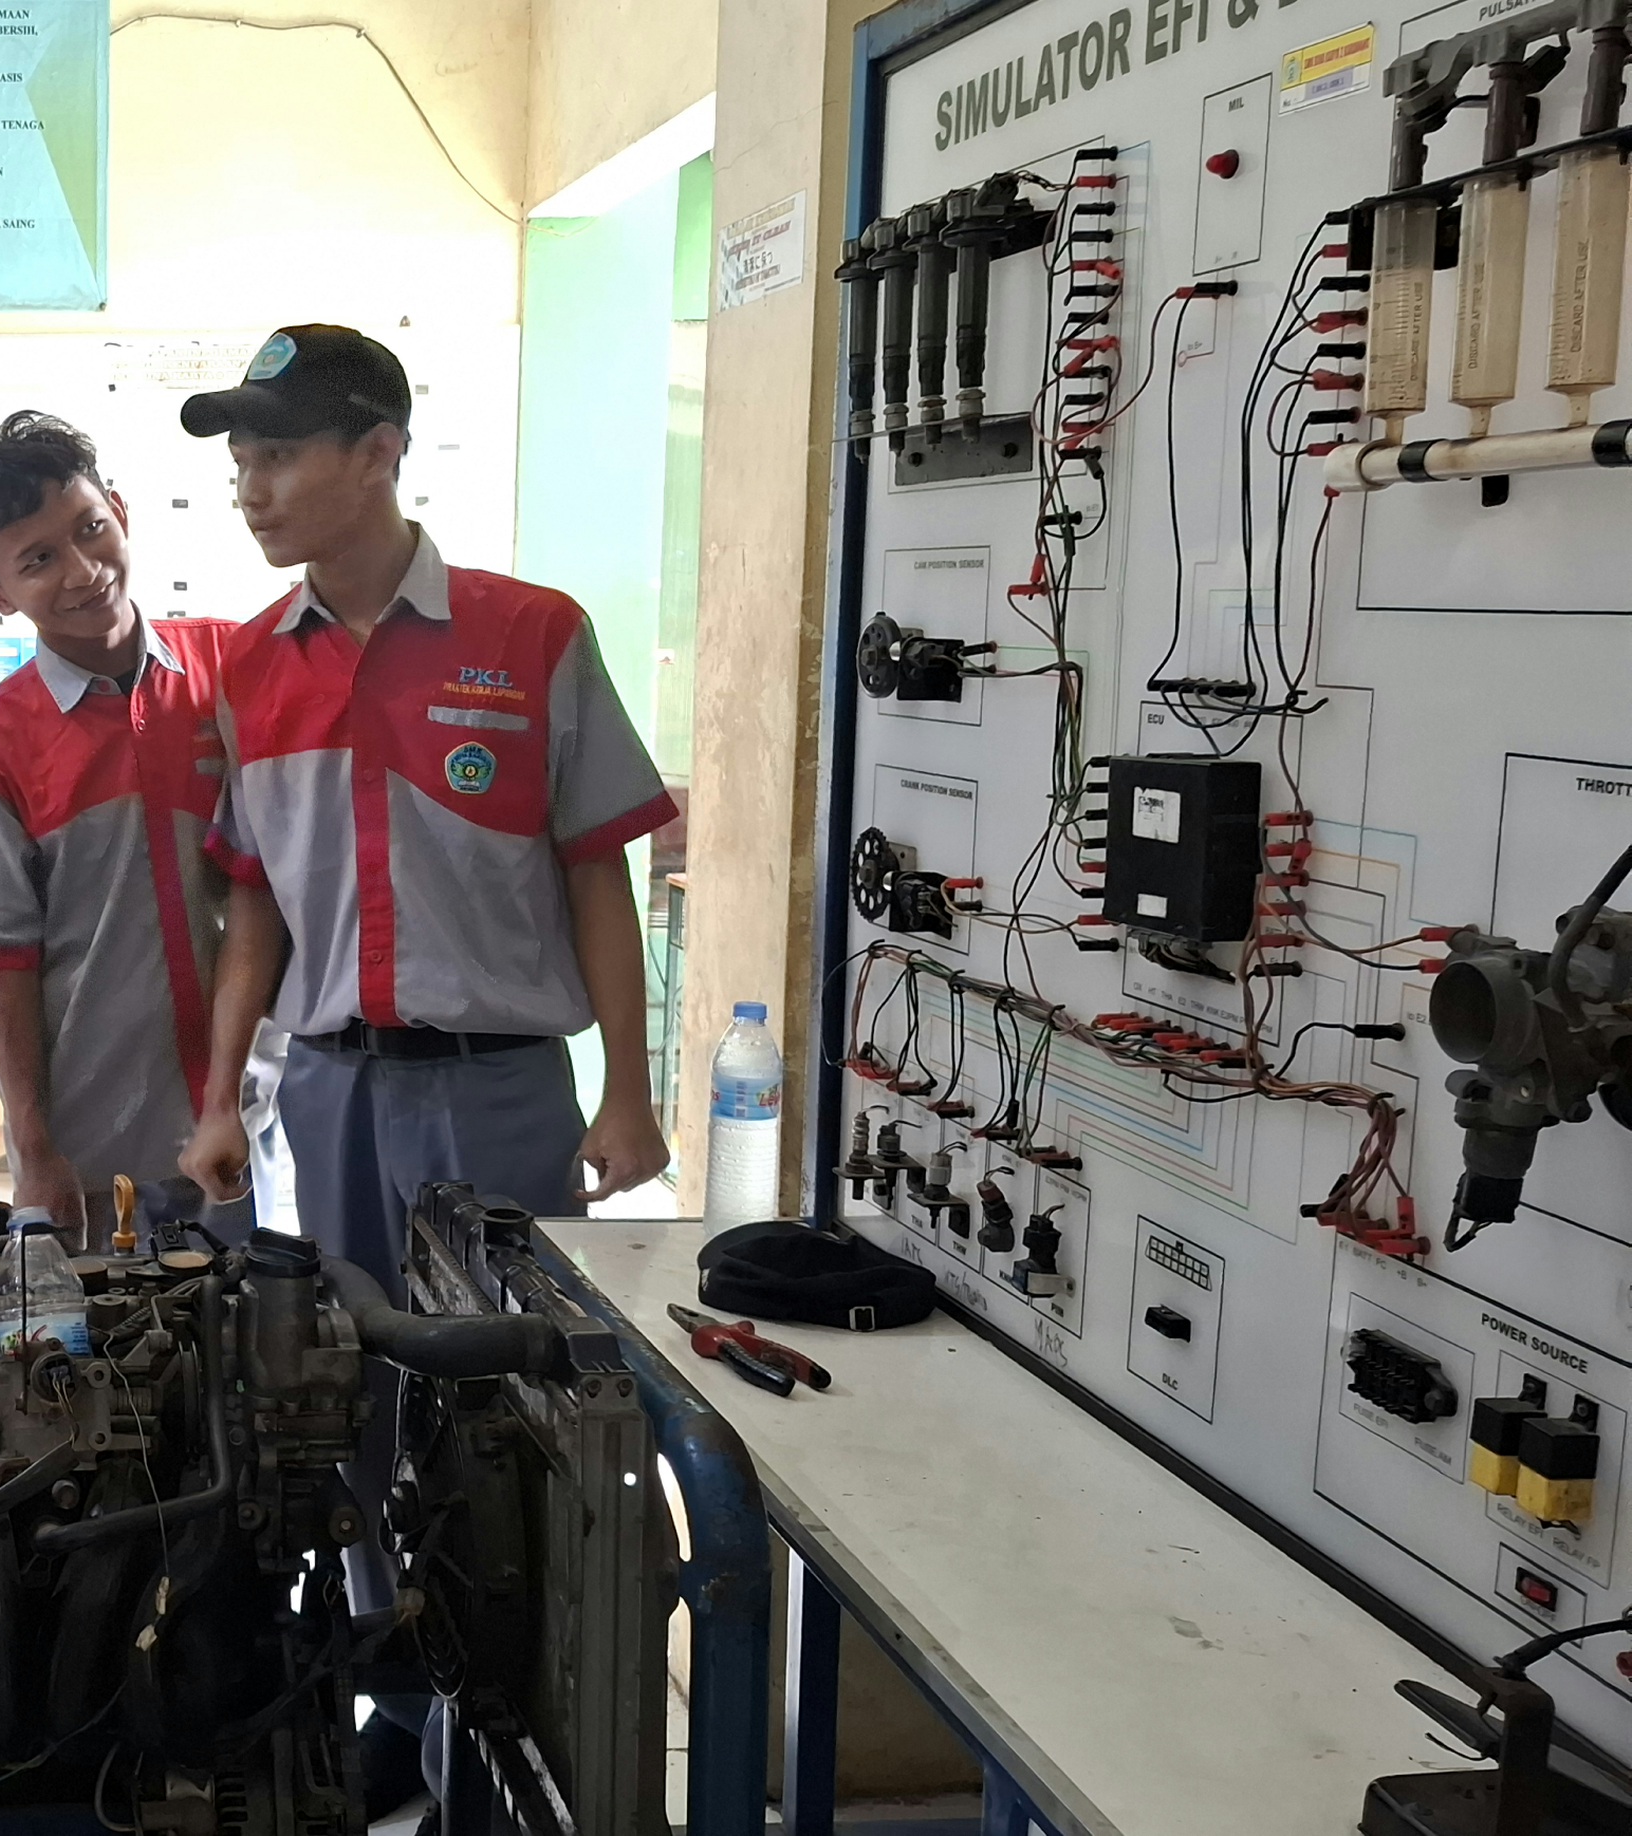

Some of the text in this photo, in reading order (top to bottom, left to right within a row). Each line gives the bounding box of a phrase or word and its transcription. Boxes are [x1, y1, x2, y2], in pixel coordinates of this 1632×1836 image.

[935, 7, 1132, 151] SIMULATOR
[1228, 96, 1245, 112] MIL
[1, 120, 44, 129] TENAGA
[3, 218, 36, 228] SAING
[1575, 265, 1587, 302] AFTER
[928, 560, 957, 569] POSITION
[958, 559, 984, 568] SENSOR
[460, 666, 513, 688] PKL
[1147, 713, 1164, 725] ECU
[900, 779, 973, 800] CRANK POSITION SENSOR
[1481, 1312, 1589, 1375] POWER SOURCE
[1162, 1372, 1178, 1390] DLC
